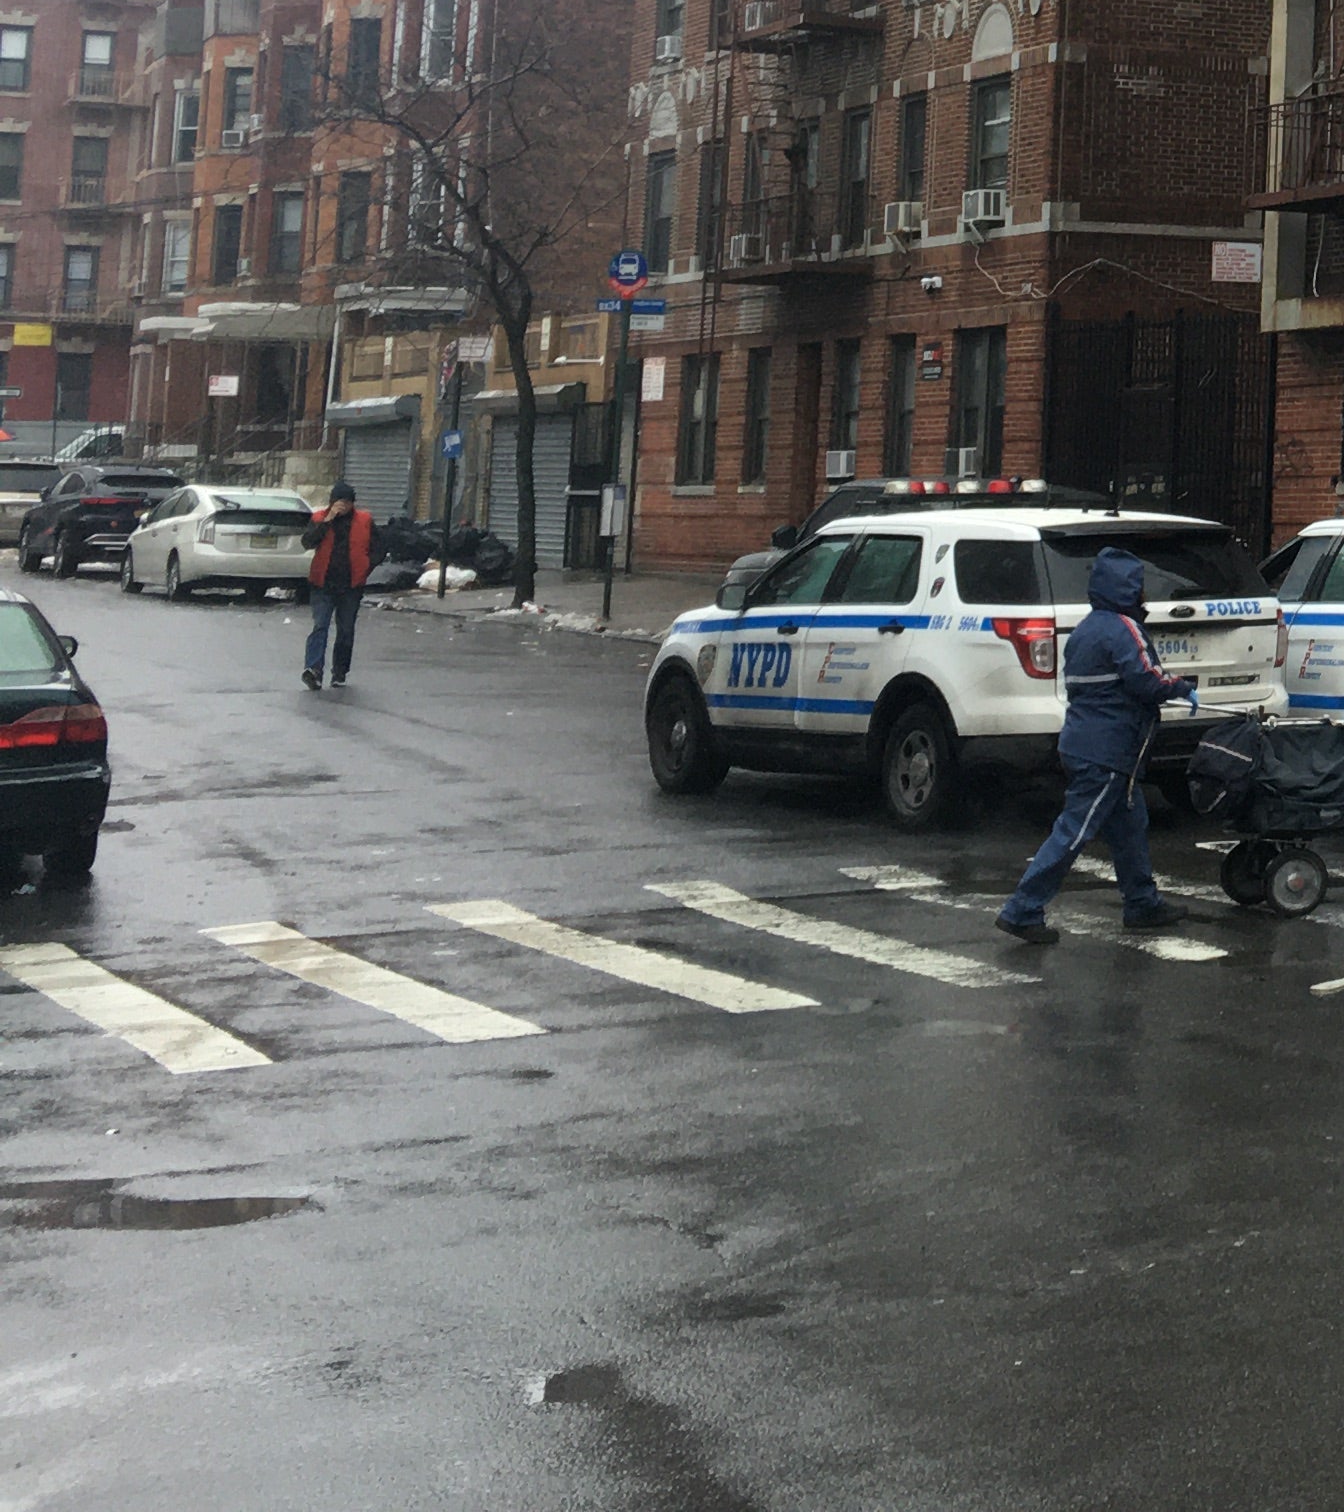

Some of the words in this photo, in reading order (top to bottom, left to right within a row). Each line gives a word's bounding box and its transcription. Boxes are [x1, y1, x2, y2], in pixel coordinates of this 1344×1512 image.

[1205, 601, 1262, 617] POLICE
[1157, 639, 1189, 655] 5604
[727, 642, 793, 689] NYPD
